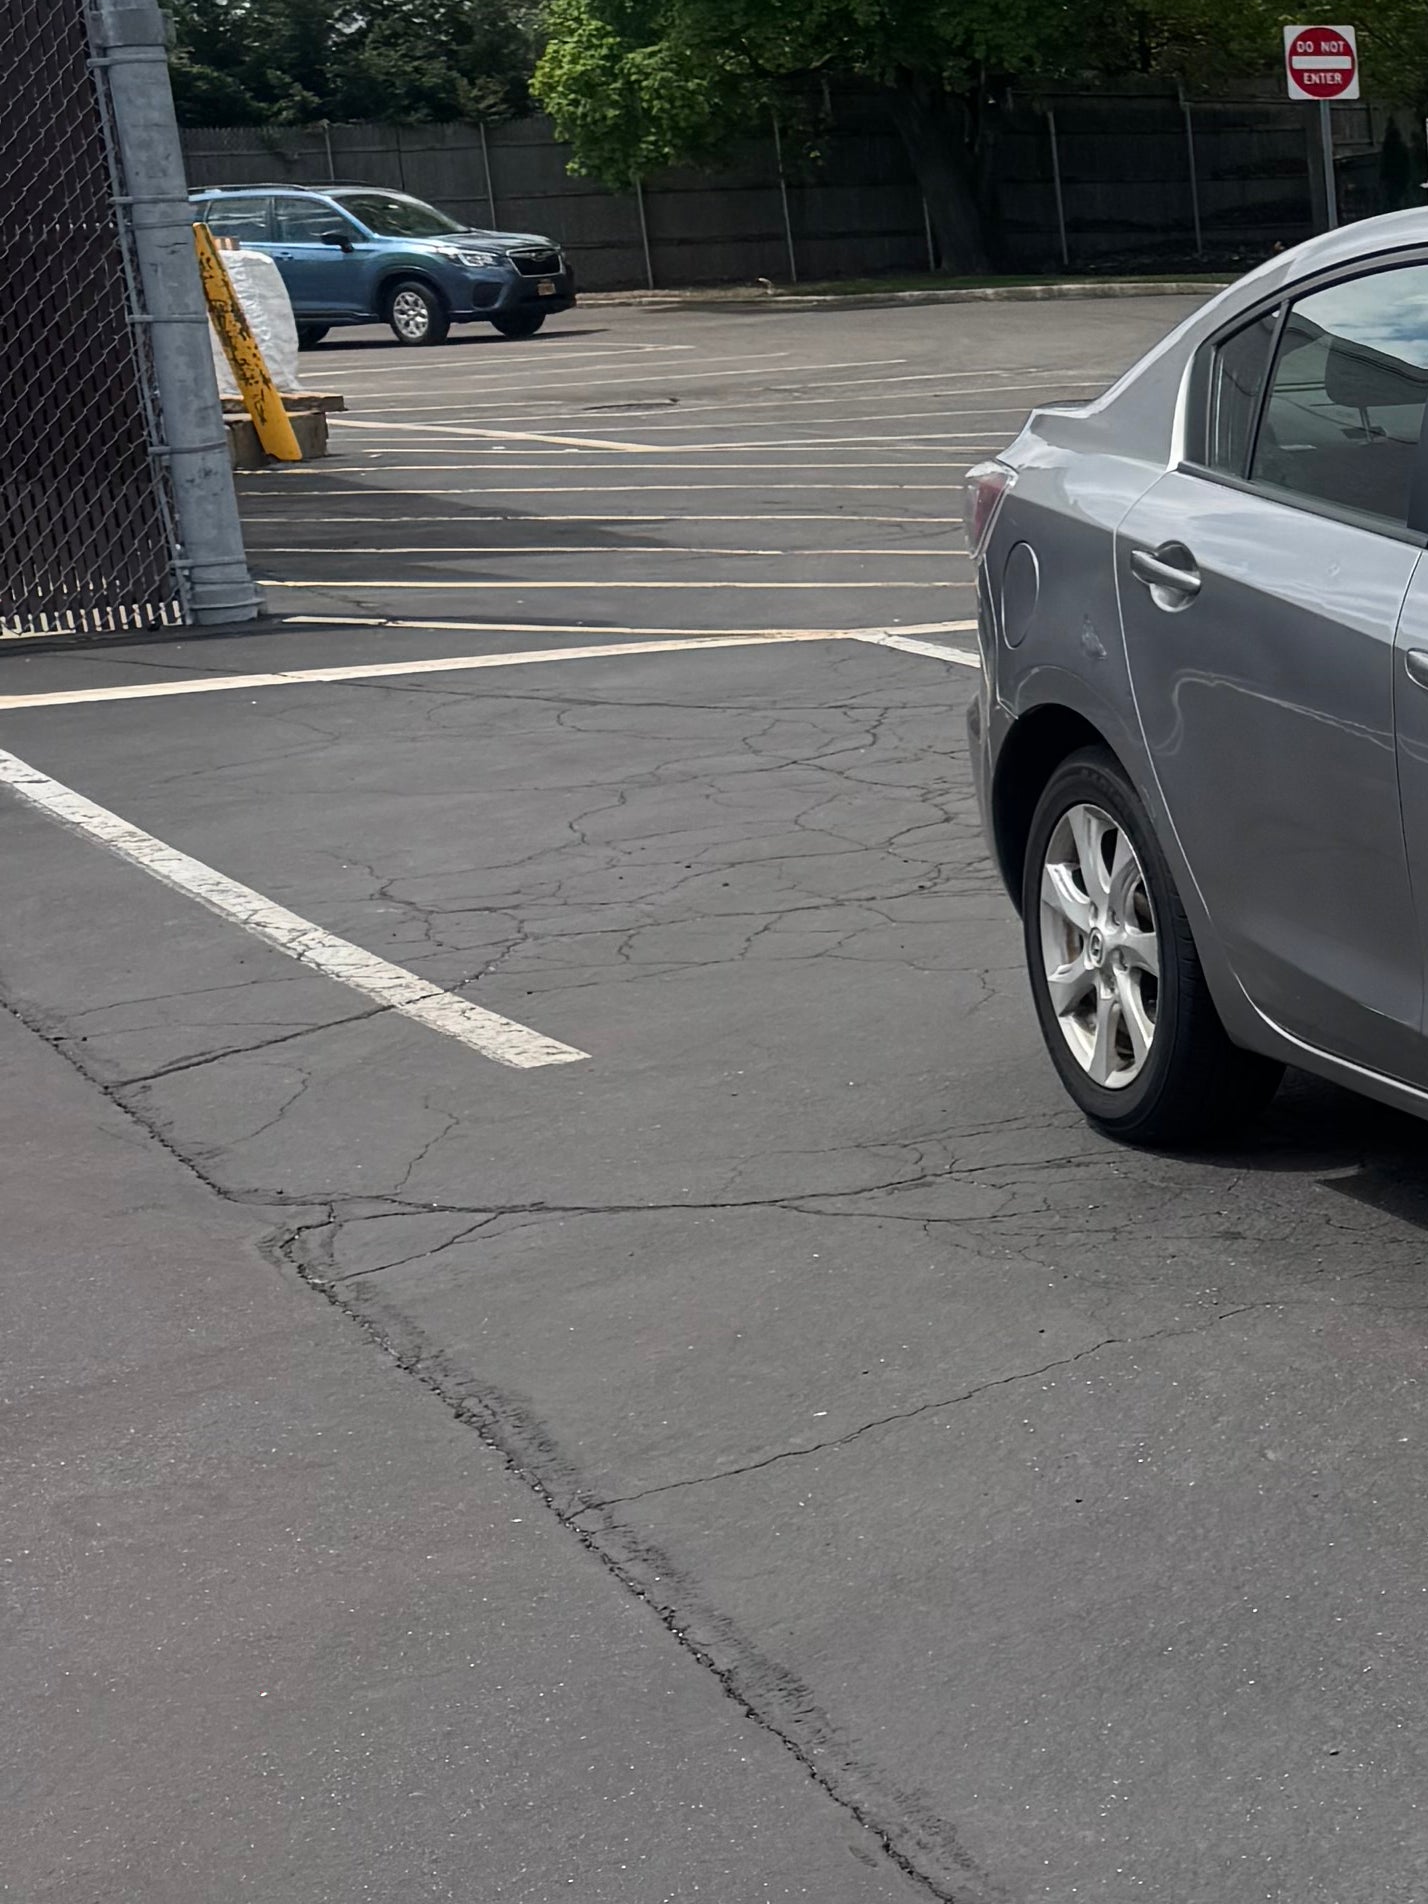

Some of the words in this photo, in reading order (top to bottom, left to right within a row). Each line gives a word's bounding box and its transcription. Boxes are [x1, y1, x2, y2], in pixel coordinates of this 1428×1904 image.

[1296, 41, 1314, 53] DO
[1320, 41, 1345, 53] NOT
[1303, 72, 1343, 85] ENTER
